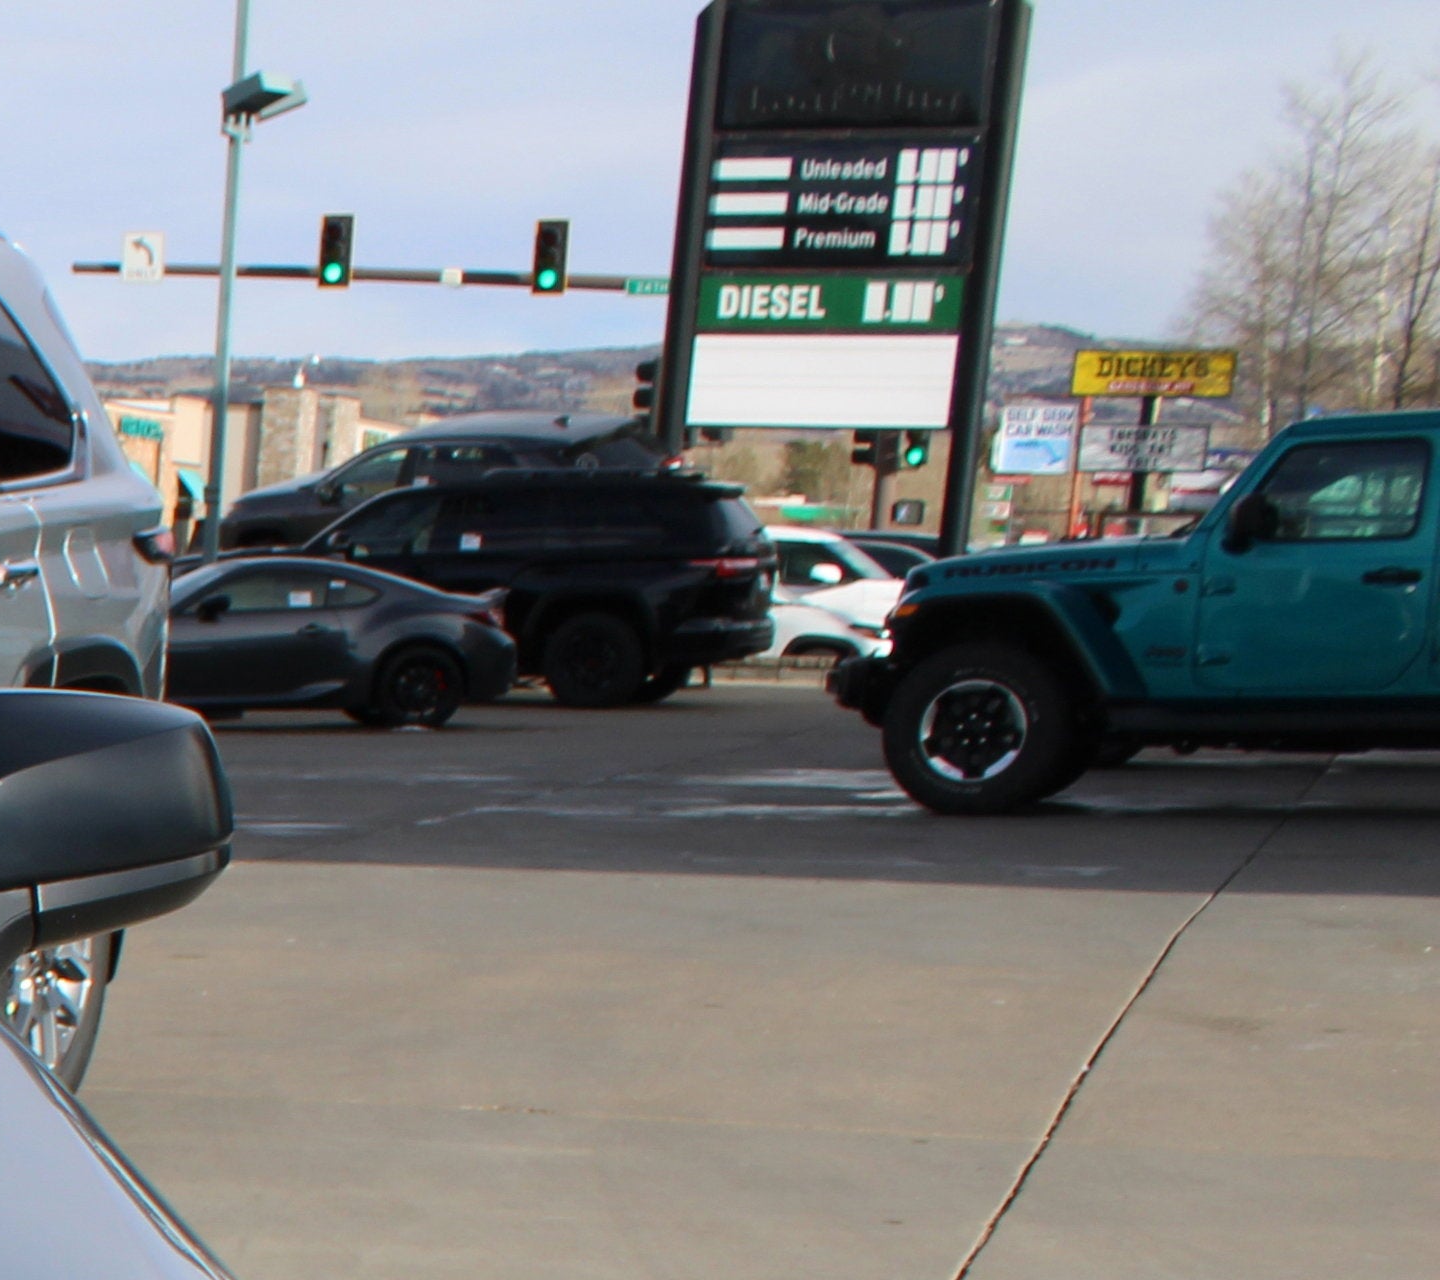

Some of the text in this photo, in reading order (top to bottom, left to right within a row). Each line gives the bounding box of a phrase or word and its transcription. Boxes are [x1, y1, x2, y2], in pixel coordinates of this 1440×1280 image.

[799, 157, 888, 181] Unleaded
[796, 191, 890, 215] Mid-Grade
[793, 226, 877, 249] Premium
[716, 283, 827, 320] DIESEL
[1006, 422, 1073, 436] CAR WASH
[943, 556, 1117, 580] RUBICON
